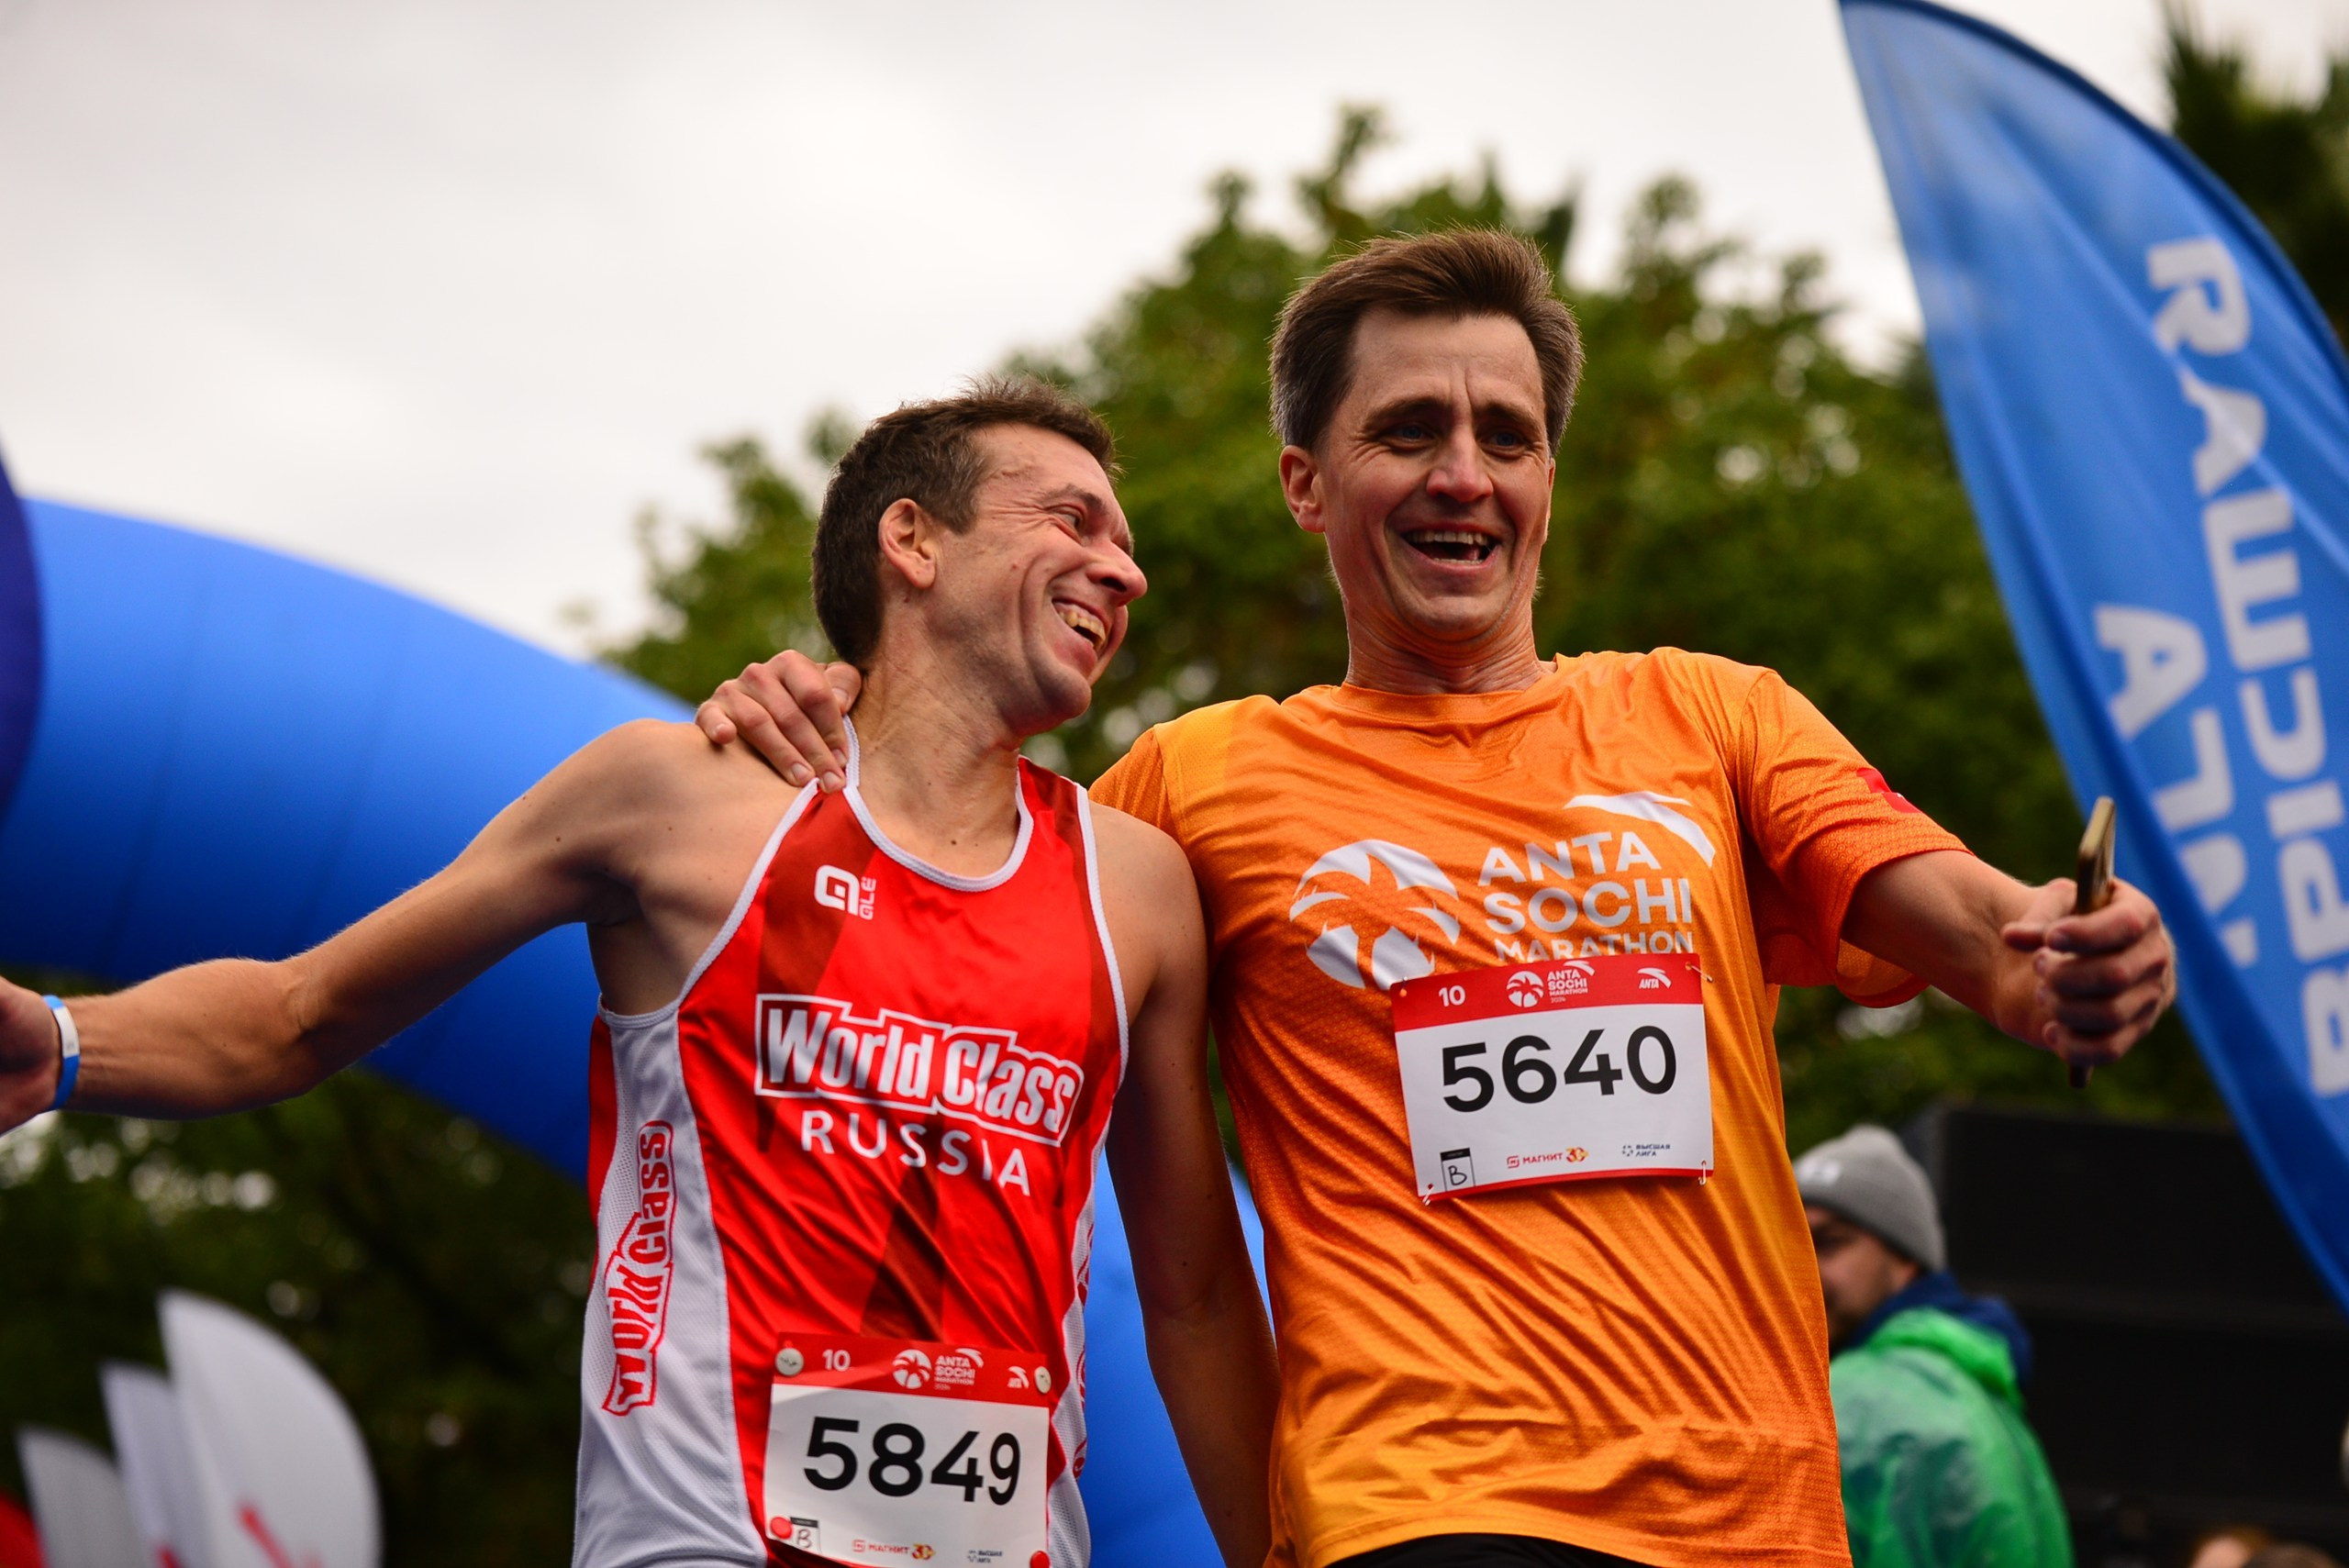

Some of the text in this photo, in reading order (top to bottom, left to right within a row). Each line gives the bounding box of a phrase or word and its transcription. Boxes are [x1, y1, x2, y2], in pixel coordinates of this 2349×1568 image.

[1477, 831, 1662, 886] ANTA
[1484, 878, 1692, 934] SOCHI
[1494, 930, 1693, 964] MARATHON
[1547, 969, 1580, 982] ANTA
[1547, 978, 1587, 992] SOCHI
[1639, 979, 1659, 989] ANTA
[1439, 985, 1466, 1007] 10
[1549, 988, 1588, 997] MARATHON
[768, 1008, 1076, 1133] World Class
[1442, 1026, 1677, 1112] 5640
[801, 1109, 1030, 1196] RUSSIA
[1523, 1152, 1563, 1165] МАГНИТ
[1448, 1165, 1467, 1186] B
[629, 1131, 670, 1264] Class
[822, 1349, 851, 1371] 10
[935, 1355, 970, 1368] ANTA
[934, 1366, 975, 1379] SOCHI
[803, 1416, 1021, 1507] 5849
